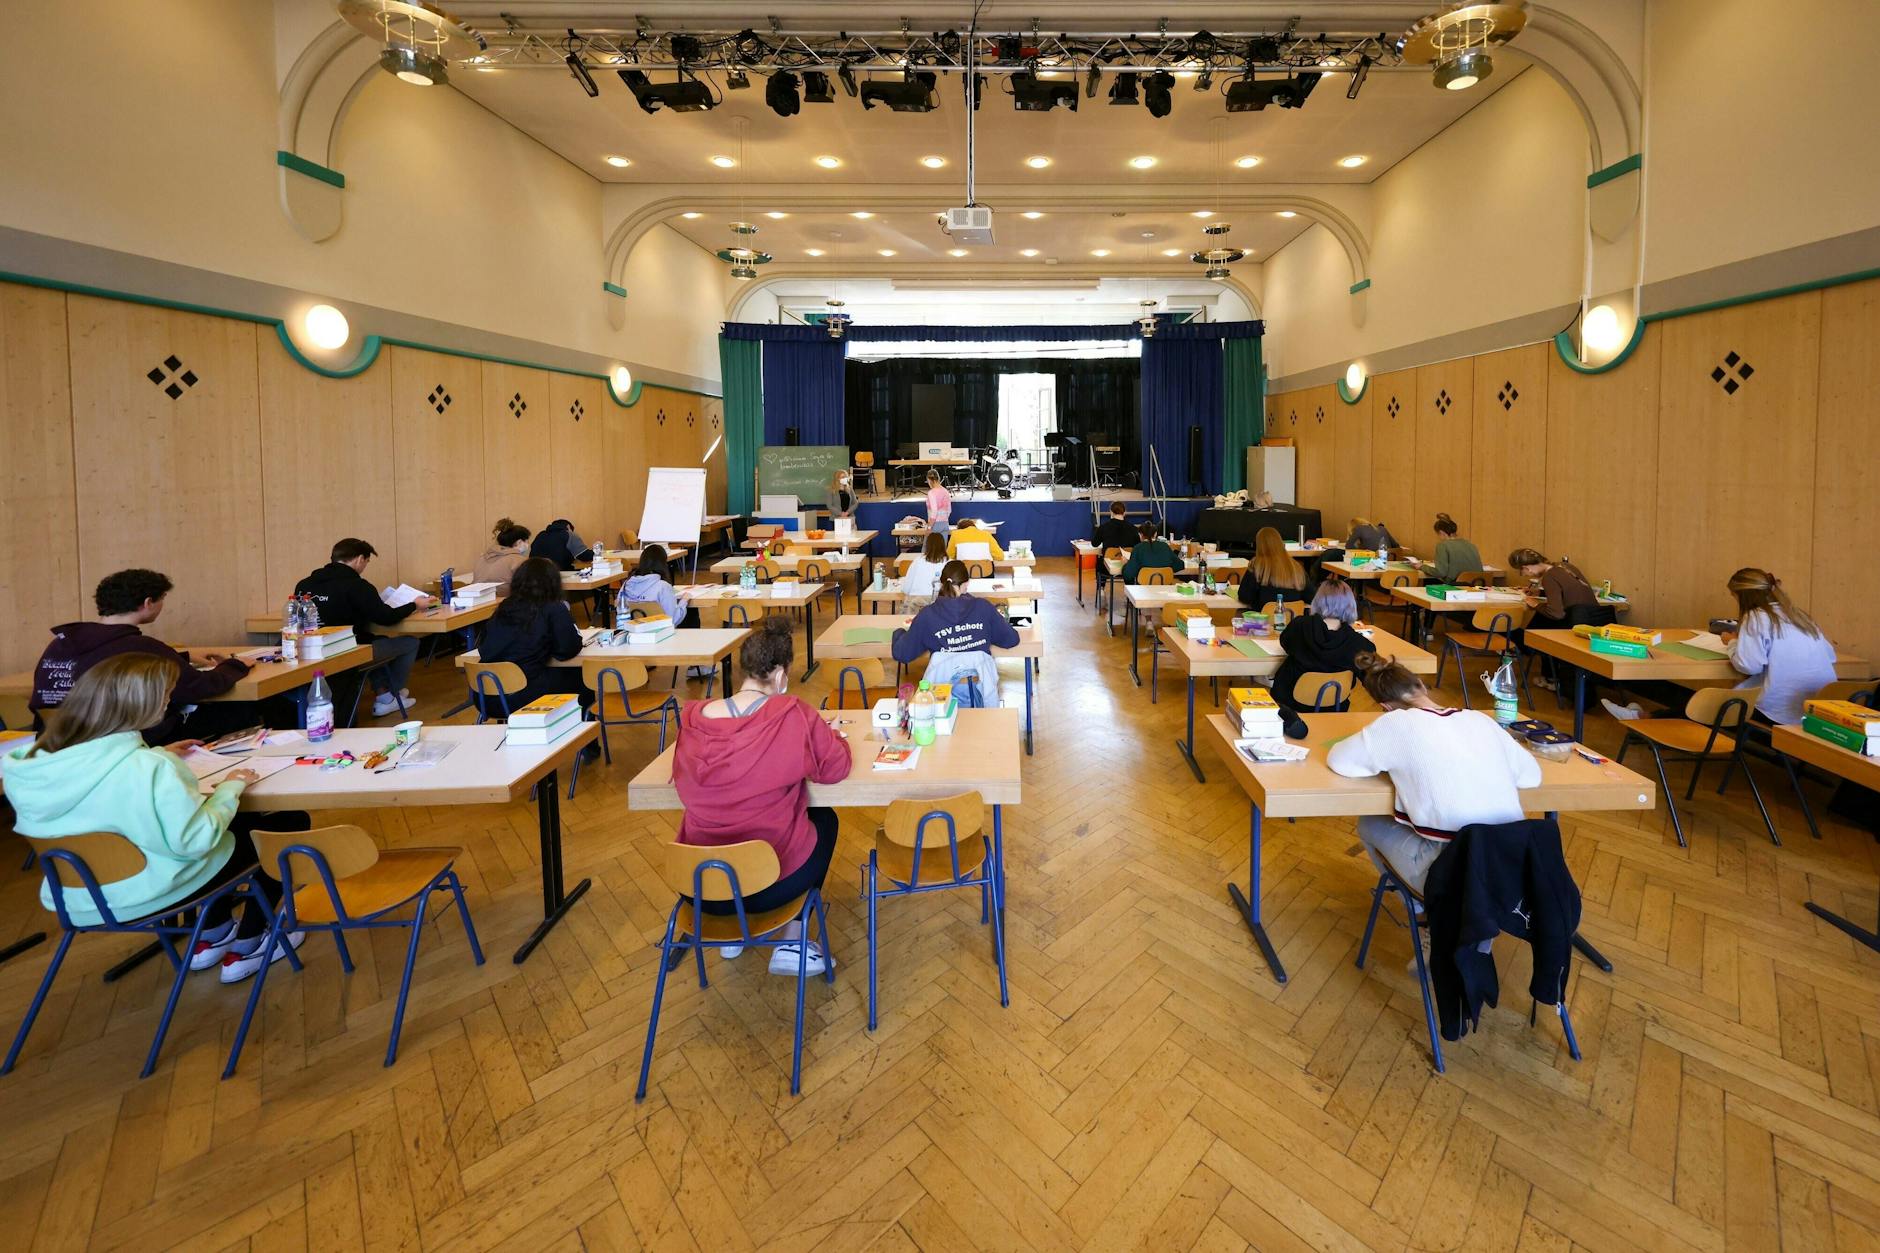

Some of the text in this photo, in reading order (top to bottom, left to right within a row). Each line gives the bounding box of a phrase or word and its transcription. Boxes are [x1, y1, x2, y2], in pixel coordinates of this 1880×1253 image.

[934, 622, 984, 639] TSV Schott
[946, 634, 973, 645] Mainz
